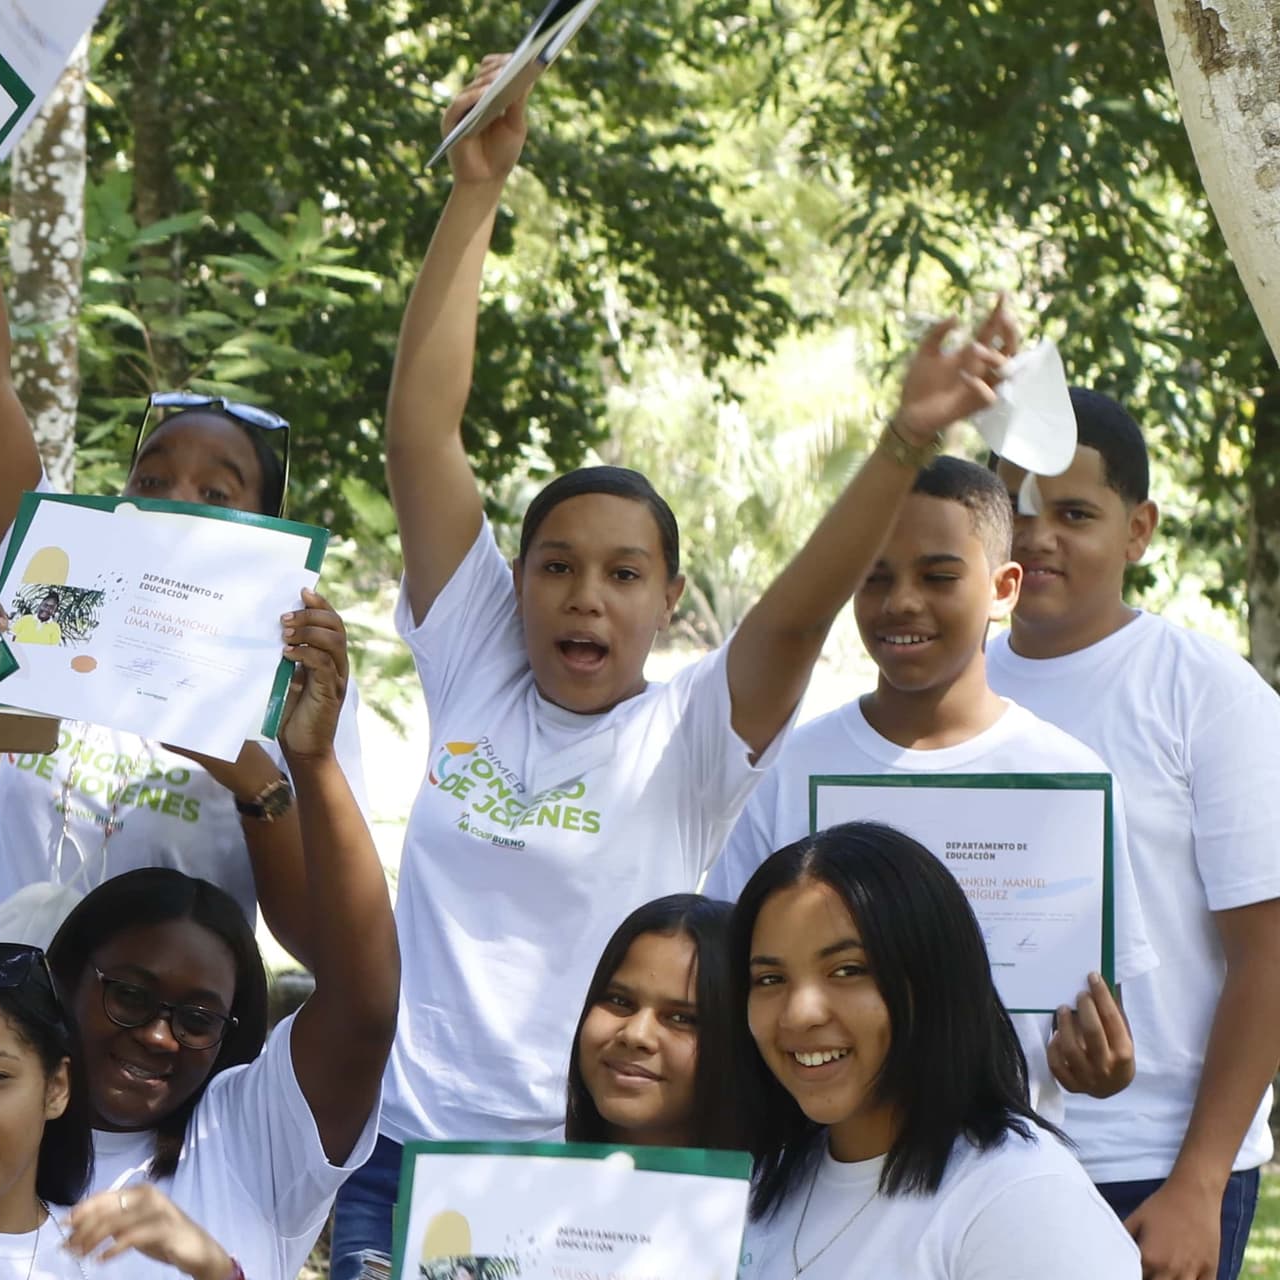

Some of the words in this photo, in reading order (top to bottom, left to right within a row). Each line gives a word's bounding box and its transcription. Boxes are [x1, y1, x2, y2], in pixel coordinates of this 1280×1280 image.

[139, 581, 189, 600] EDUCACIÓN
[142, 572, 211, 597] DEPARTAMENTO
[212, 591, 224, 600] DE
[153, 622, 184, 638] TAPIA
[17, 754, 59, 781] DE
[439, 773, 477, 800] DE
[945, 841, 1015, 850] DEPARTAMENTO
[1017, 843, 1028, 851] DE
[945, 850, 996, 860] EDUCACIÓN
[1002, 877, 1046, 888] MANUEL
